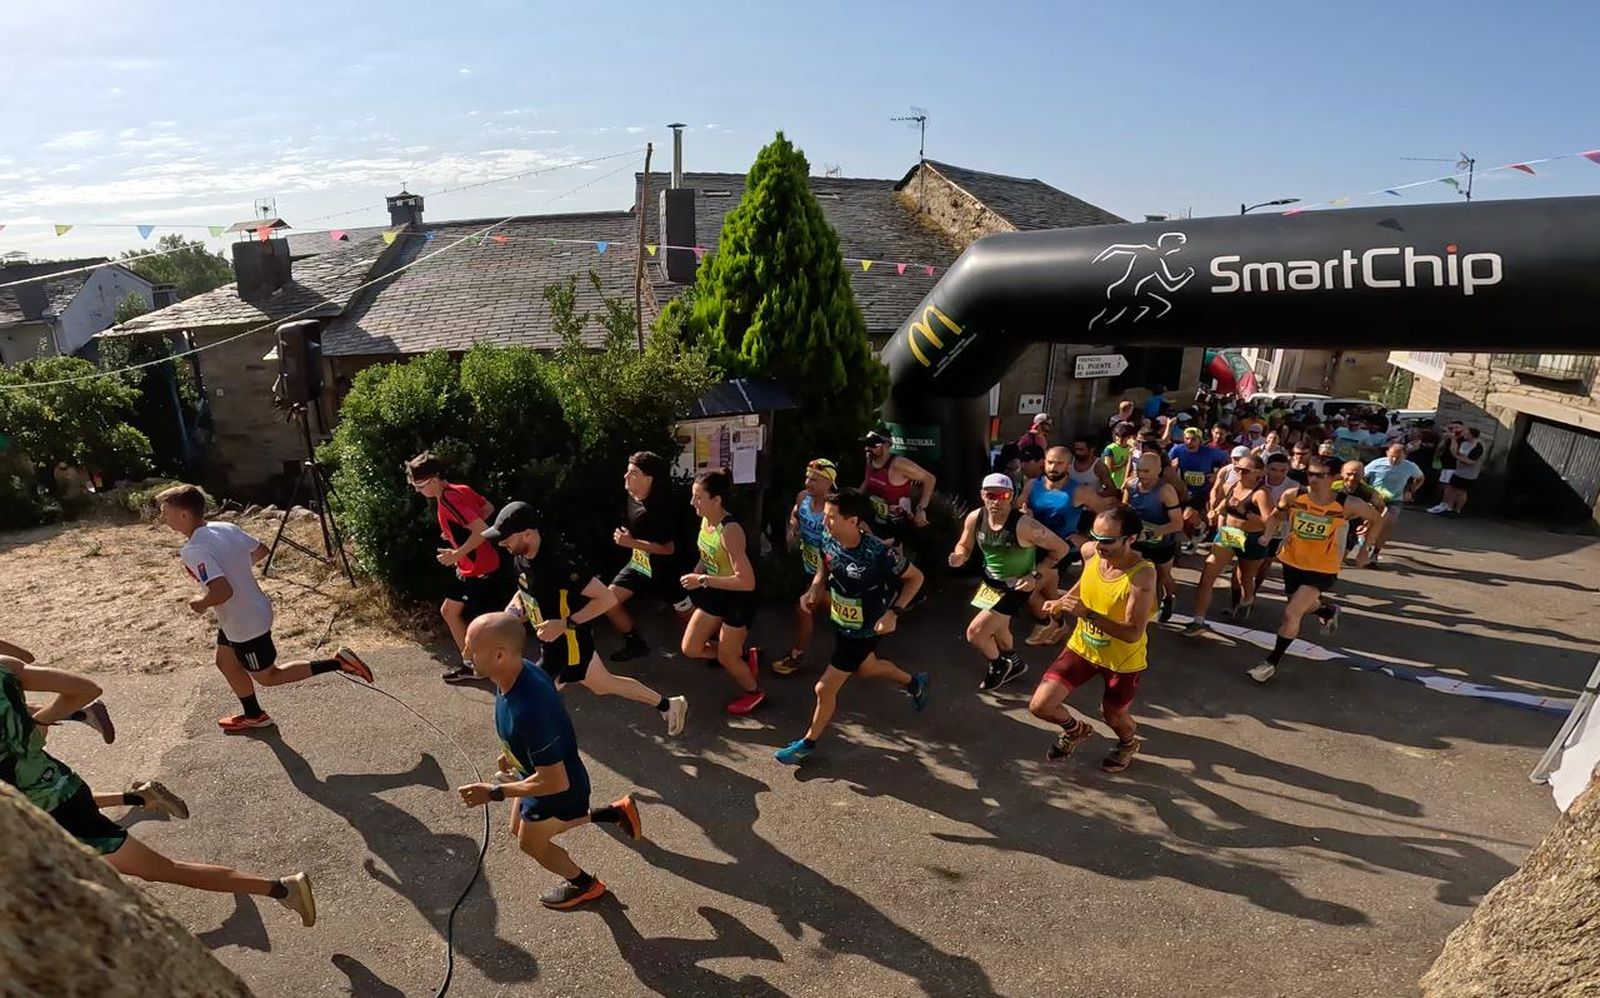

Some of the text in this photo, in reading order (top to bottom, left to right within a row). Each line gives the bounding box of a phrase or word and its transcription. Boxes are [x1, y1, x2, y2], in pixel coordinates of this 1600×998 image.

[1210, 244, 1503, 295] SmartChip
[1077, 363, 1085, 371] EL
[1087, 361, 1112, 370] PUENTE
[1297, 519, 1326, 535] 759
